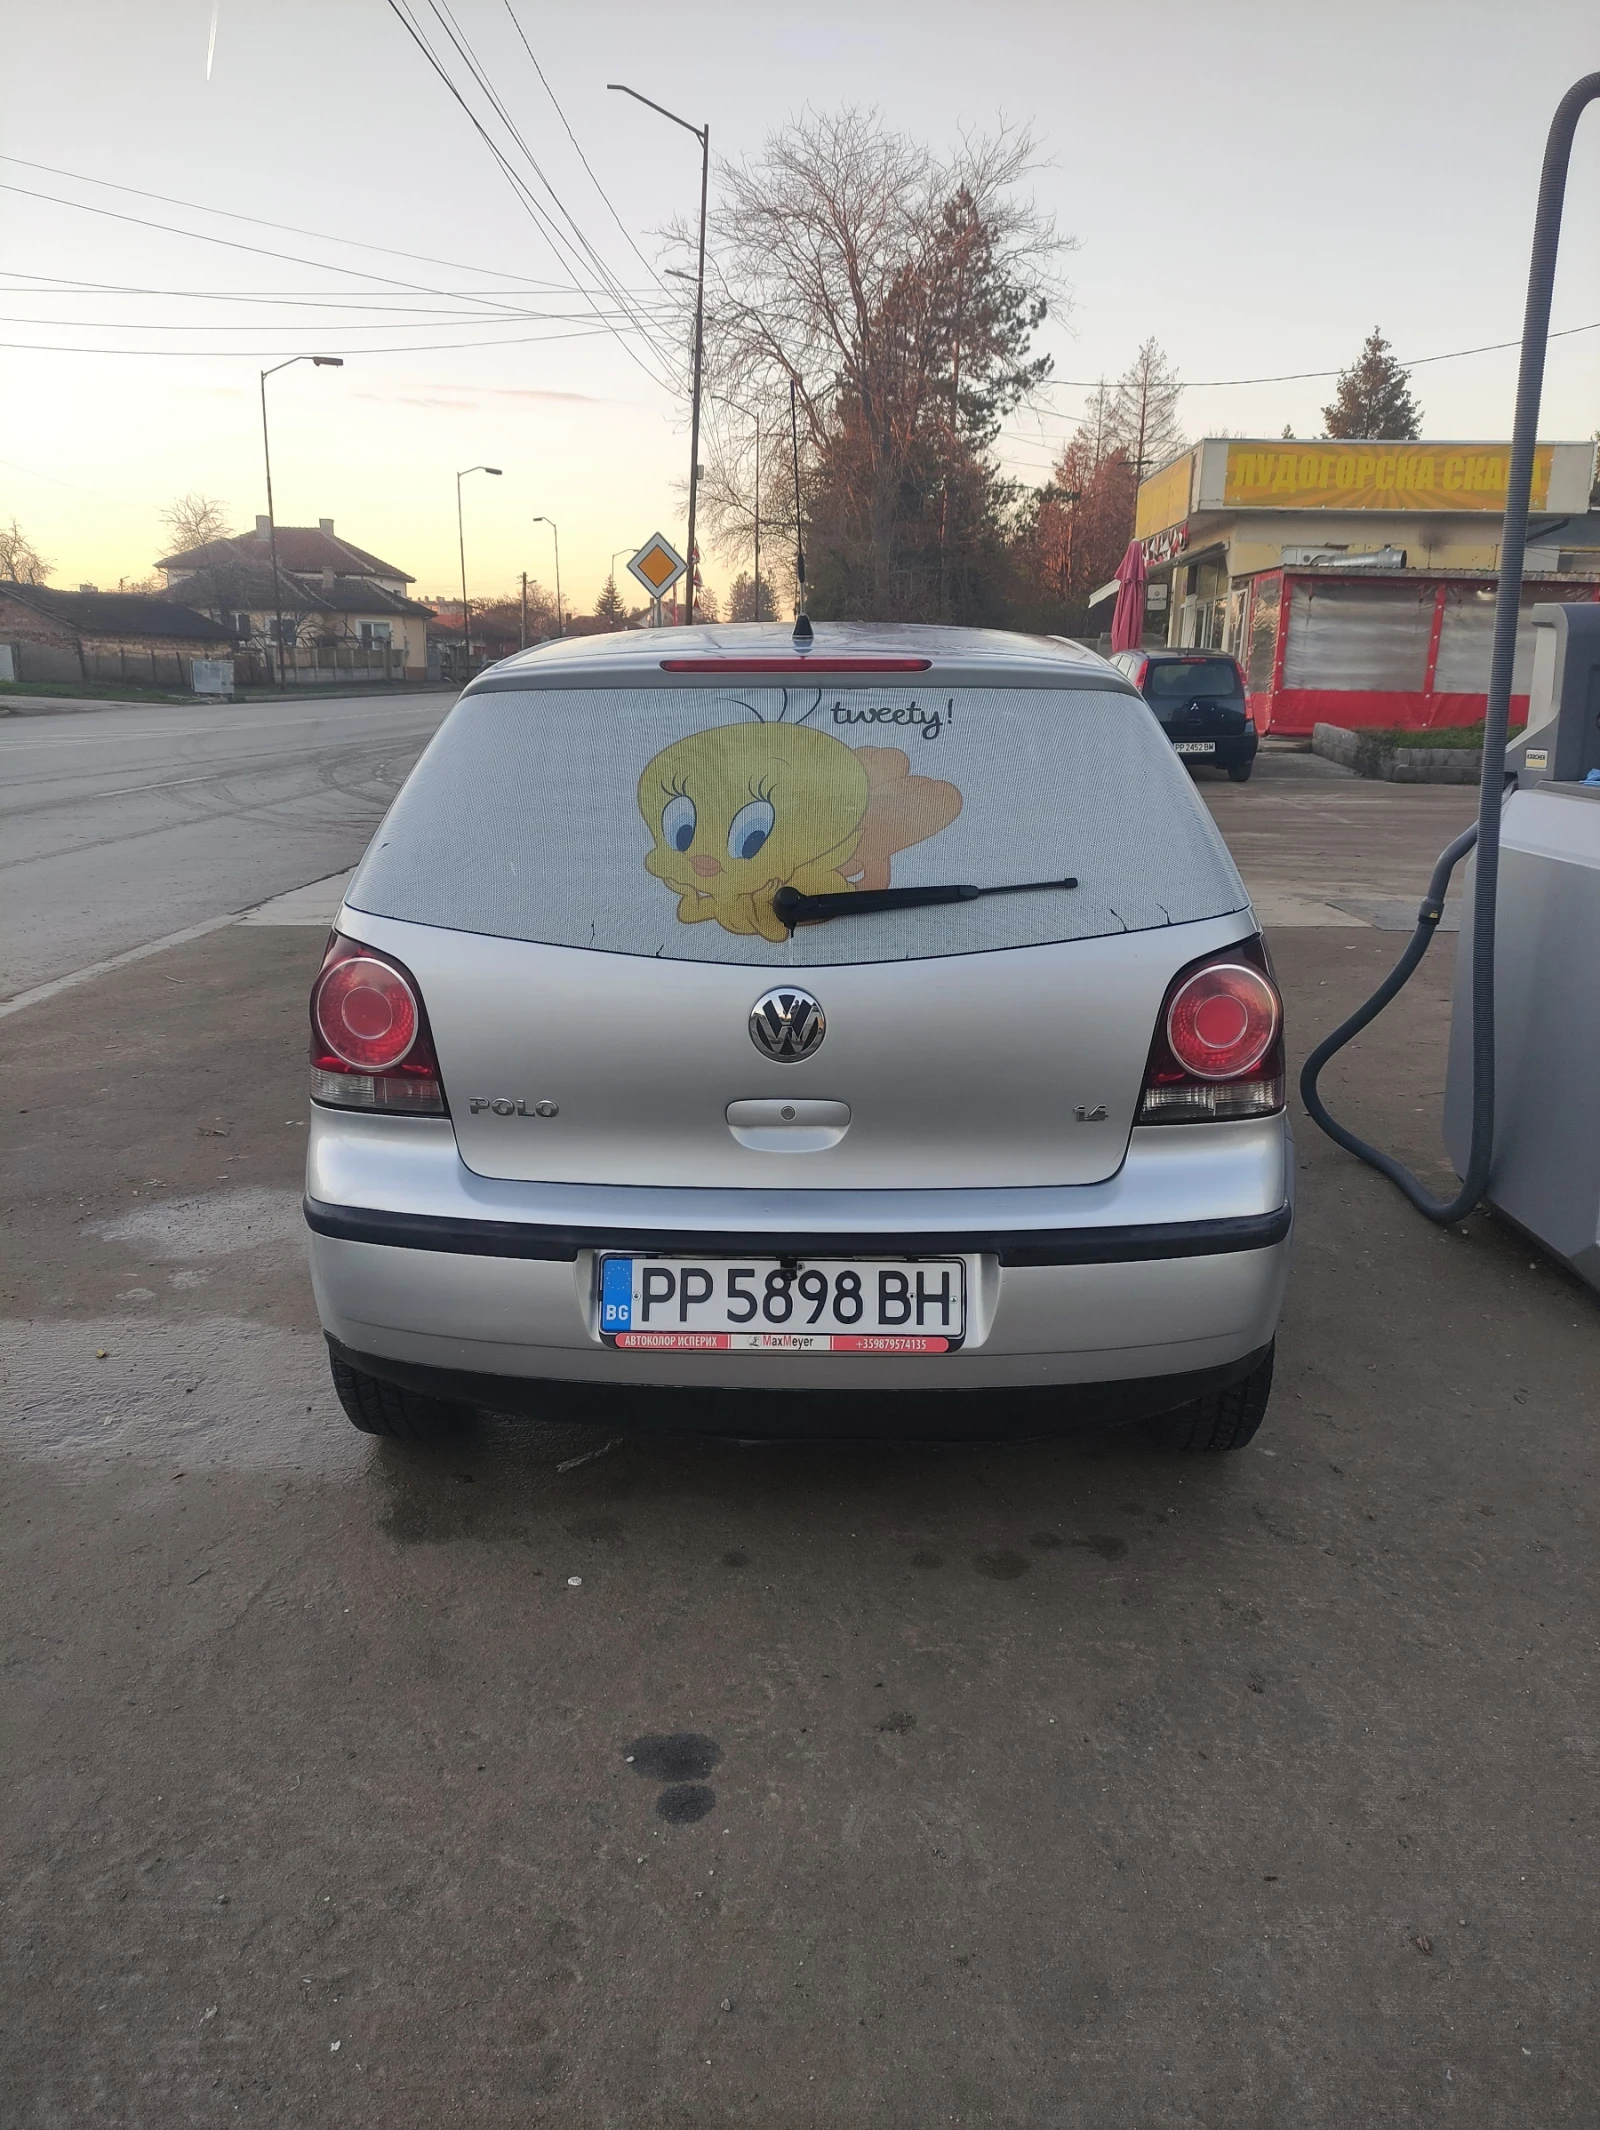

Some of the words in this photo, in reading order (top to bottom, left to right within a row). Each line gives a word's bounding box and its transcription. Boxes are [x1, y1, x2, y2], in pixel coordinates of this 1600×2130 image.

[1232, 453, 1435, 493] ЛУДОГОРСКА
[830, 698, 955, 740] tweety!
[469, 1096, 559, 1118] POLO
[641, 1267, 714, 1323] PP
[726, 1268, 864, 1325] 5898
[877, 1270, 950, 1326] BH
[605, 1304, 629, 1321] BG
[624, 1335, 676, 1347] АВТОКОЛОР
[677, 1335, 718, 1347] ИСПЕРИХ
[762, 1335, 814, 1350] MaxMeyer
[855, 1338, 927, 1350] +359879574135
